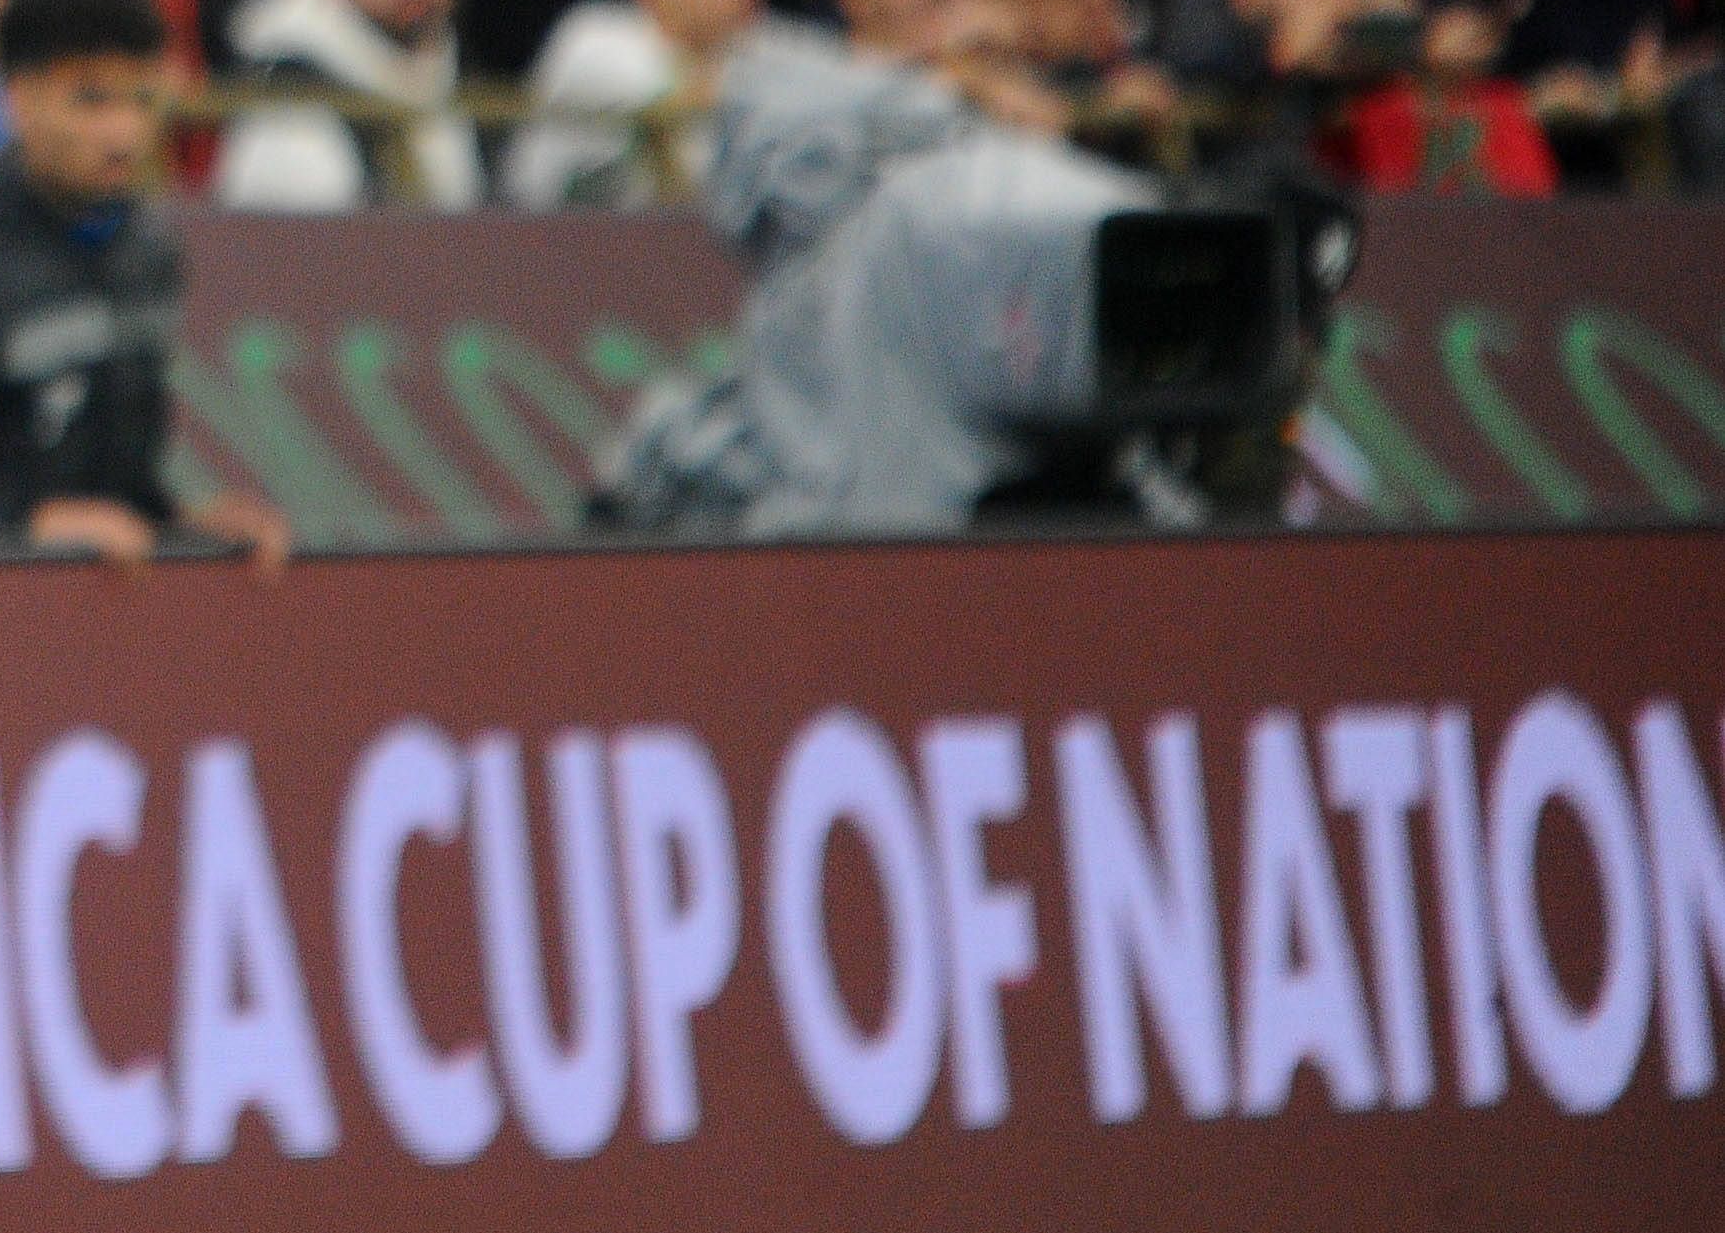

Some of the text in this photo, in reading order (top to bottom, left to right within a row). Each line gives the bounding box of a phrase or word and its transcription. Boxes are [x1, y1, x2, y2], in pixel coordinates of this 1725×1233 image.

[341, 726, 738, 1161] CUP
[769, 710, 1035, 1141] OF
[1058, 698, 1725, 1118] NATION
